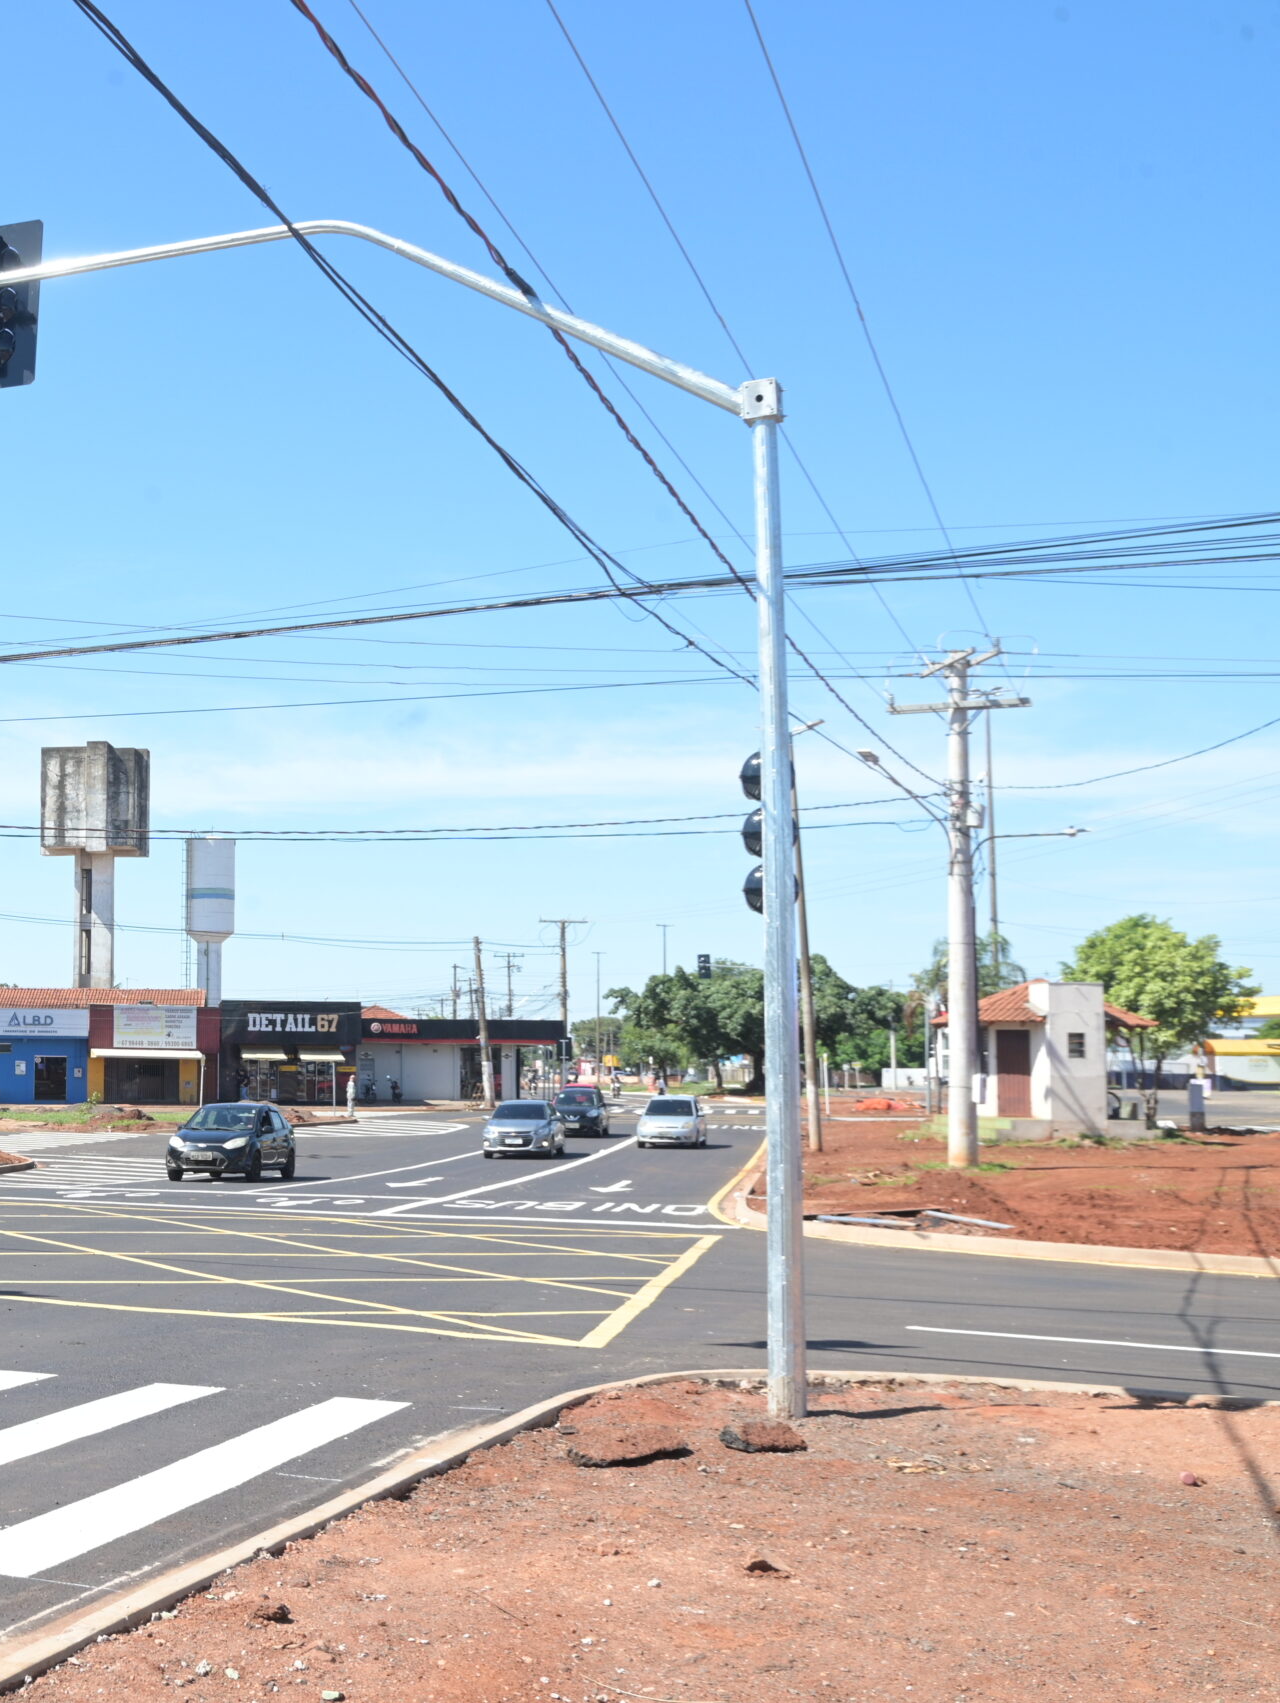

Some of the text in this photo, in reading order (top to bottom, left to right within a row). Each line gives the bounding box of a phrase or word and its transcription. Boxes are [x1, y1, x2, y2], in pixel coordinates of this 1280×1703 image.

[247, 1013, 339, 1032] DETAIL 67
[382, 1023, 418, 1034] YAMAHA
[442, 1199, 708, 1216] ONIBUS
